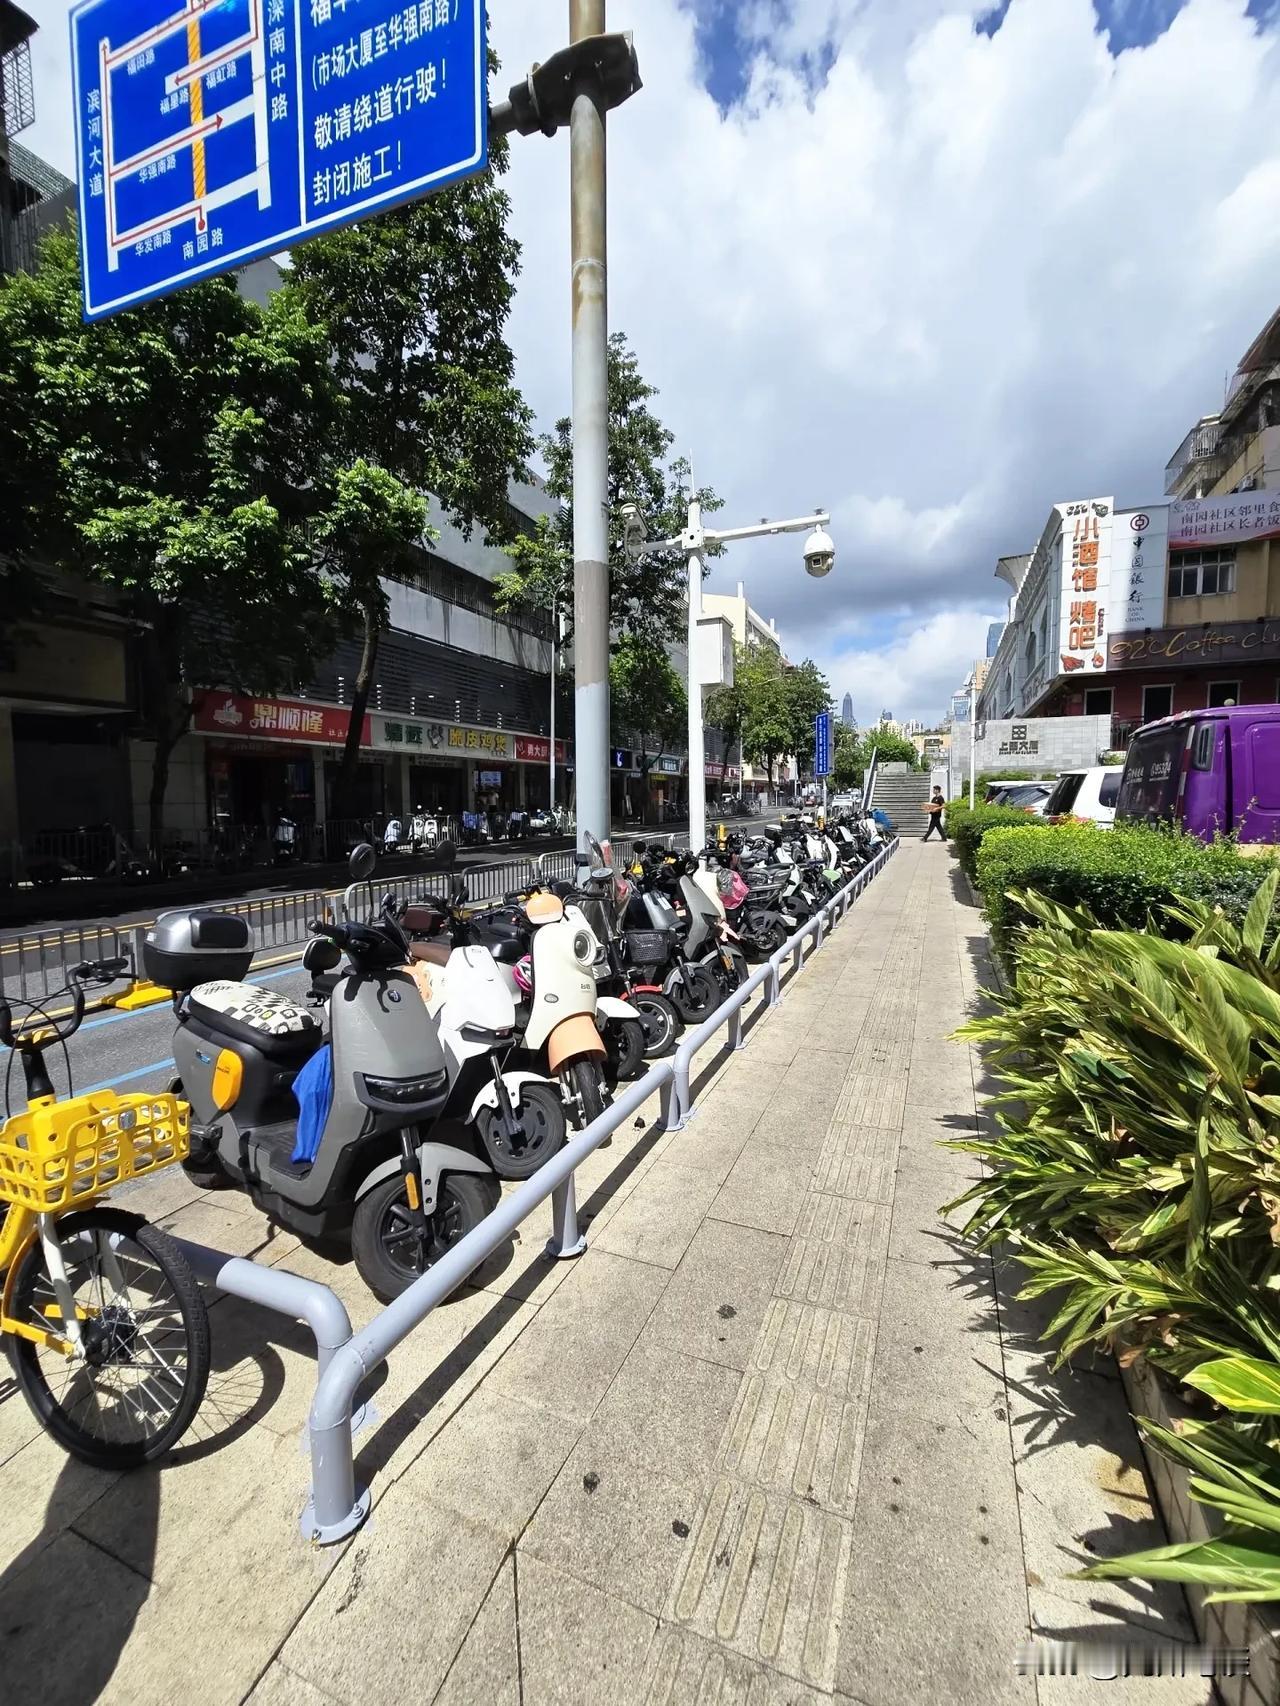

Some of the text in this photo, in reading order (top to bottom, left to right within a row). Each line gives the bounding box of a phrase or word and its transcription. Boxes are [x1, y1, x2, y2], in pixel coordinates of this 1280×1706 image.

[127, 48, 155, 75] 福田路
[206, 61, 237, 90] 福虹路
[268, 0, 288, 122] 深南中路
[160, 87, 189, 115] 福星路
[314, 58, 447, 150] 敬请绕道行驶！
[87, 88, 103, 198] 滨河大道
[138, 155, 176, 184] 华强南路
[313, 145, 402, 207] 封闭施工！
[135, 229, 172, 257] 华发南路
[183, 228, 224, 260] 南园路
[1069, 517, 1100, 651] 小酒馆 烤吧
[250, 703, 323, 733] 鼎顺隆
